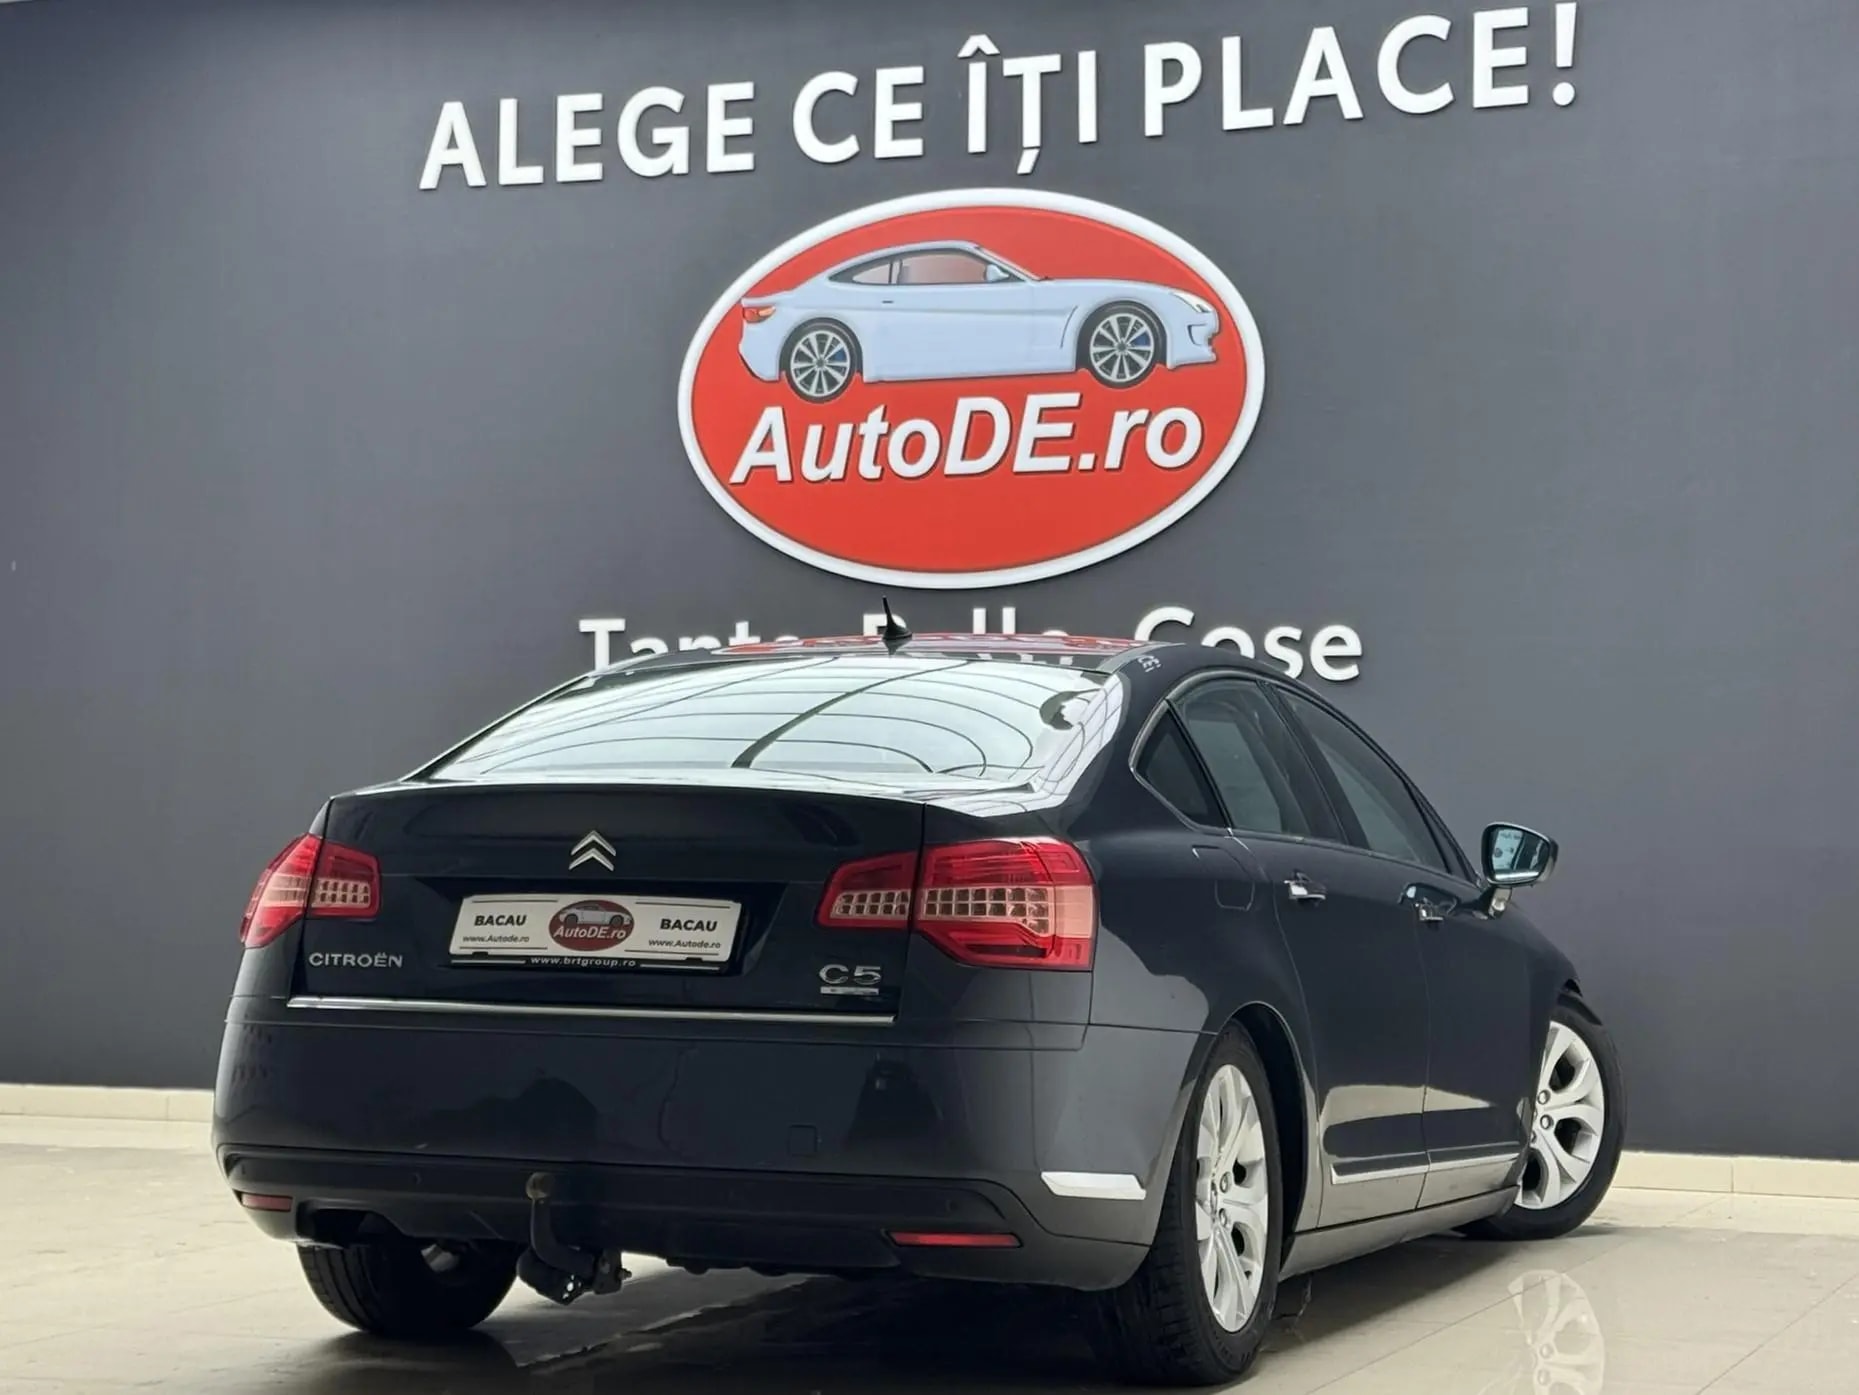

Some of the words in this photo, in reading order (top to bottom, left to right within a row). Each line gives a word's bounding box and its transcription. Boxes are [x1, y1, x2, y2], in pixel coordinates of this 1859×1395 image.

[418, 80, 755, 191] ALEGE
[792, 65, 925, 164] CE
[1143, 2, 1578, 138] PLACE!
[729, 391, 1203, 484] AutoDE.ro
[474, 914, 527, 927] BACAU
[659, 917, 718, 932] BACAU
[553, 925, 627, 940] AutoDE.ro
[648, 938, 722, 949] www.Autode.ro
[308, 952, 403, 968] CITROËN
[819, 963, 882, 985] C5
